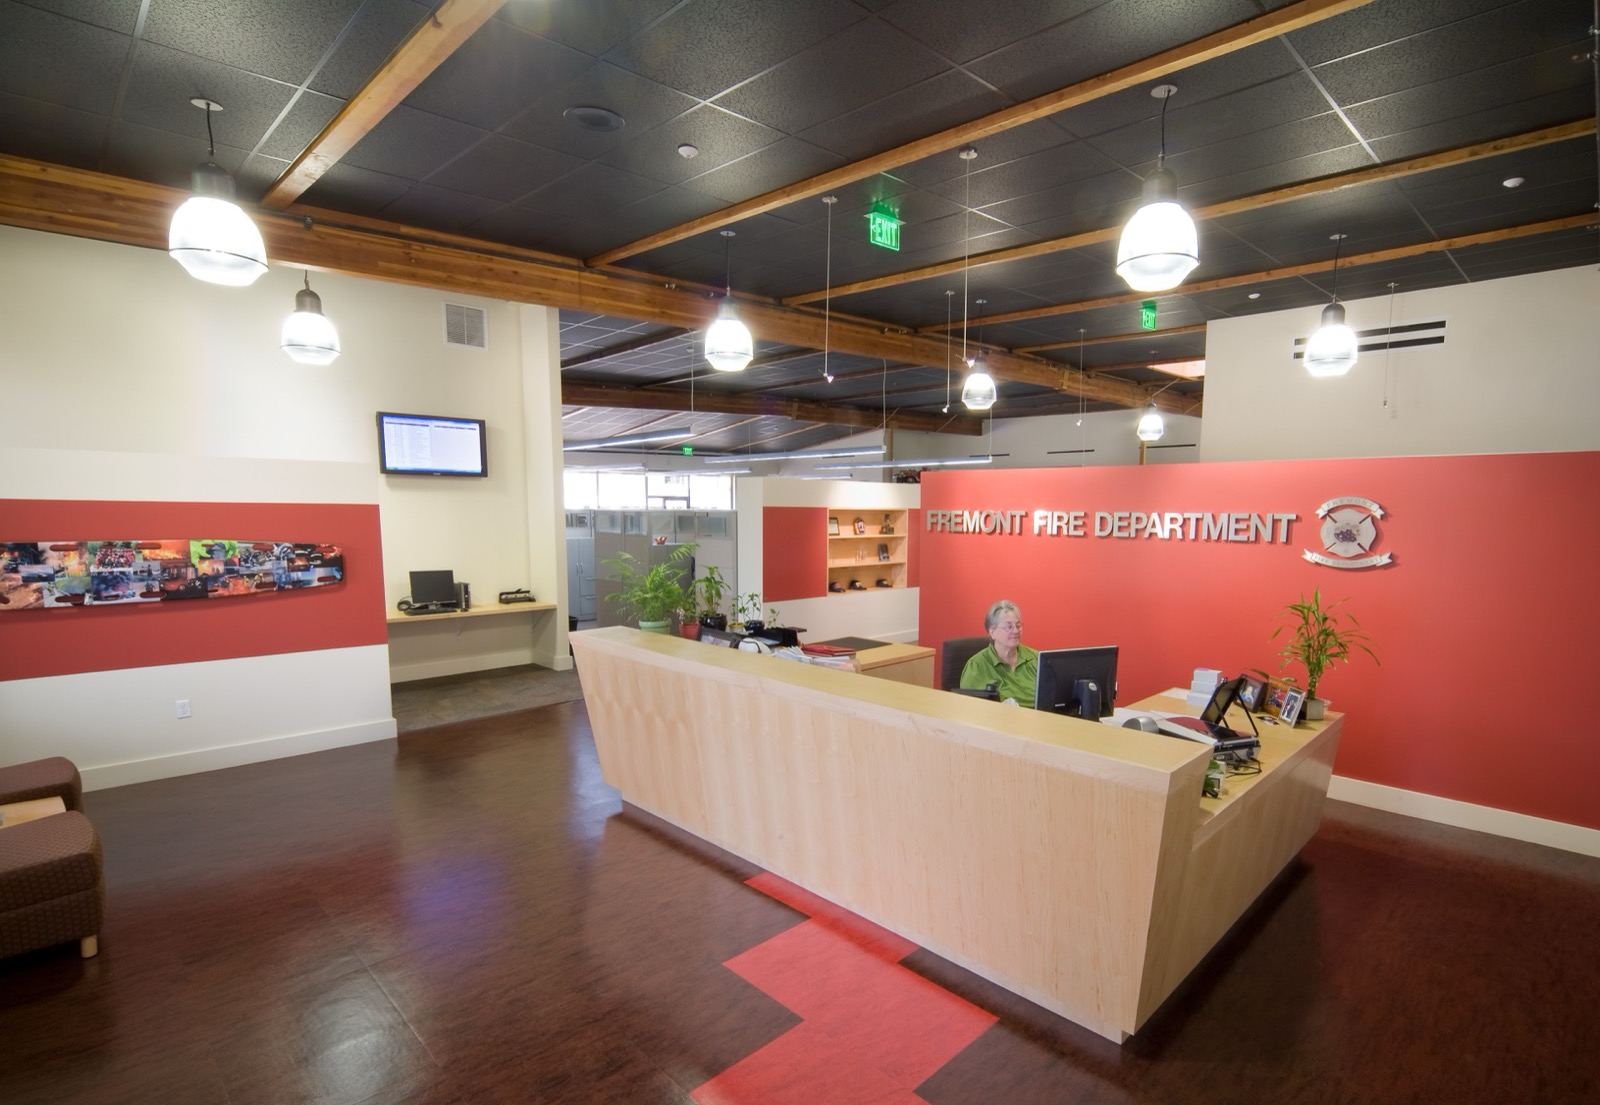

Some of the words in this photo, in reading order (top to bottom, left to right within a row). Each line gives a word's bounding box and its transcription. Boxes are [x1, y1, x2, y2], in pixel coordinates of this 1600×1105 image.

[875, 217, 898, 247] EXIT
[926, 509, 1026, 534] FREMONT
[1033, 509, 1085, 536] FIRE
[1094, 511, 1297, 543] DEPARTMENT
